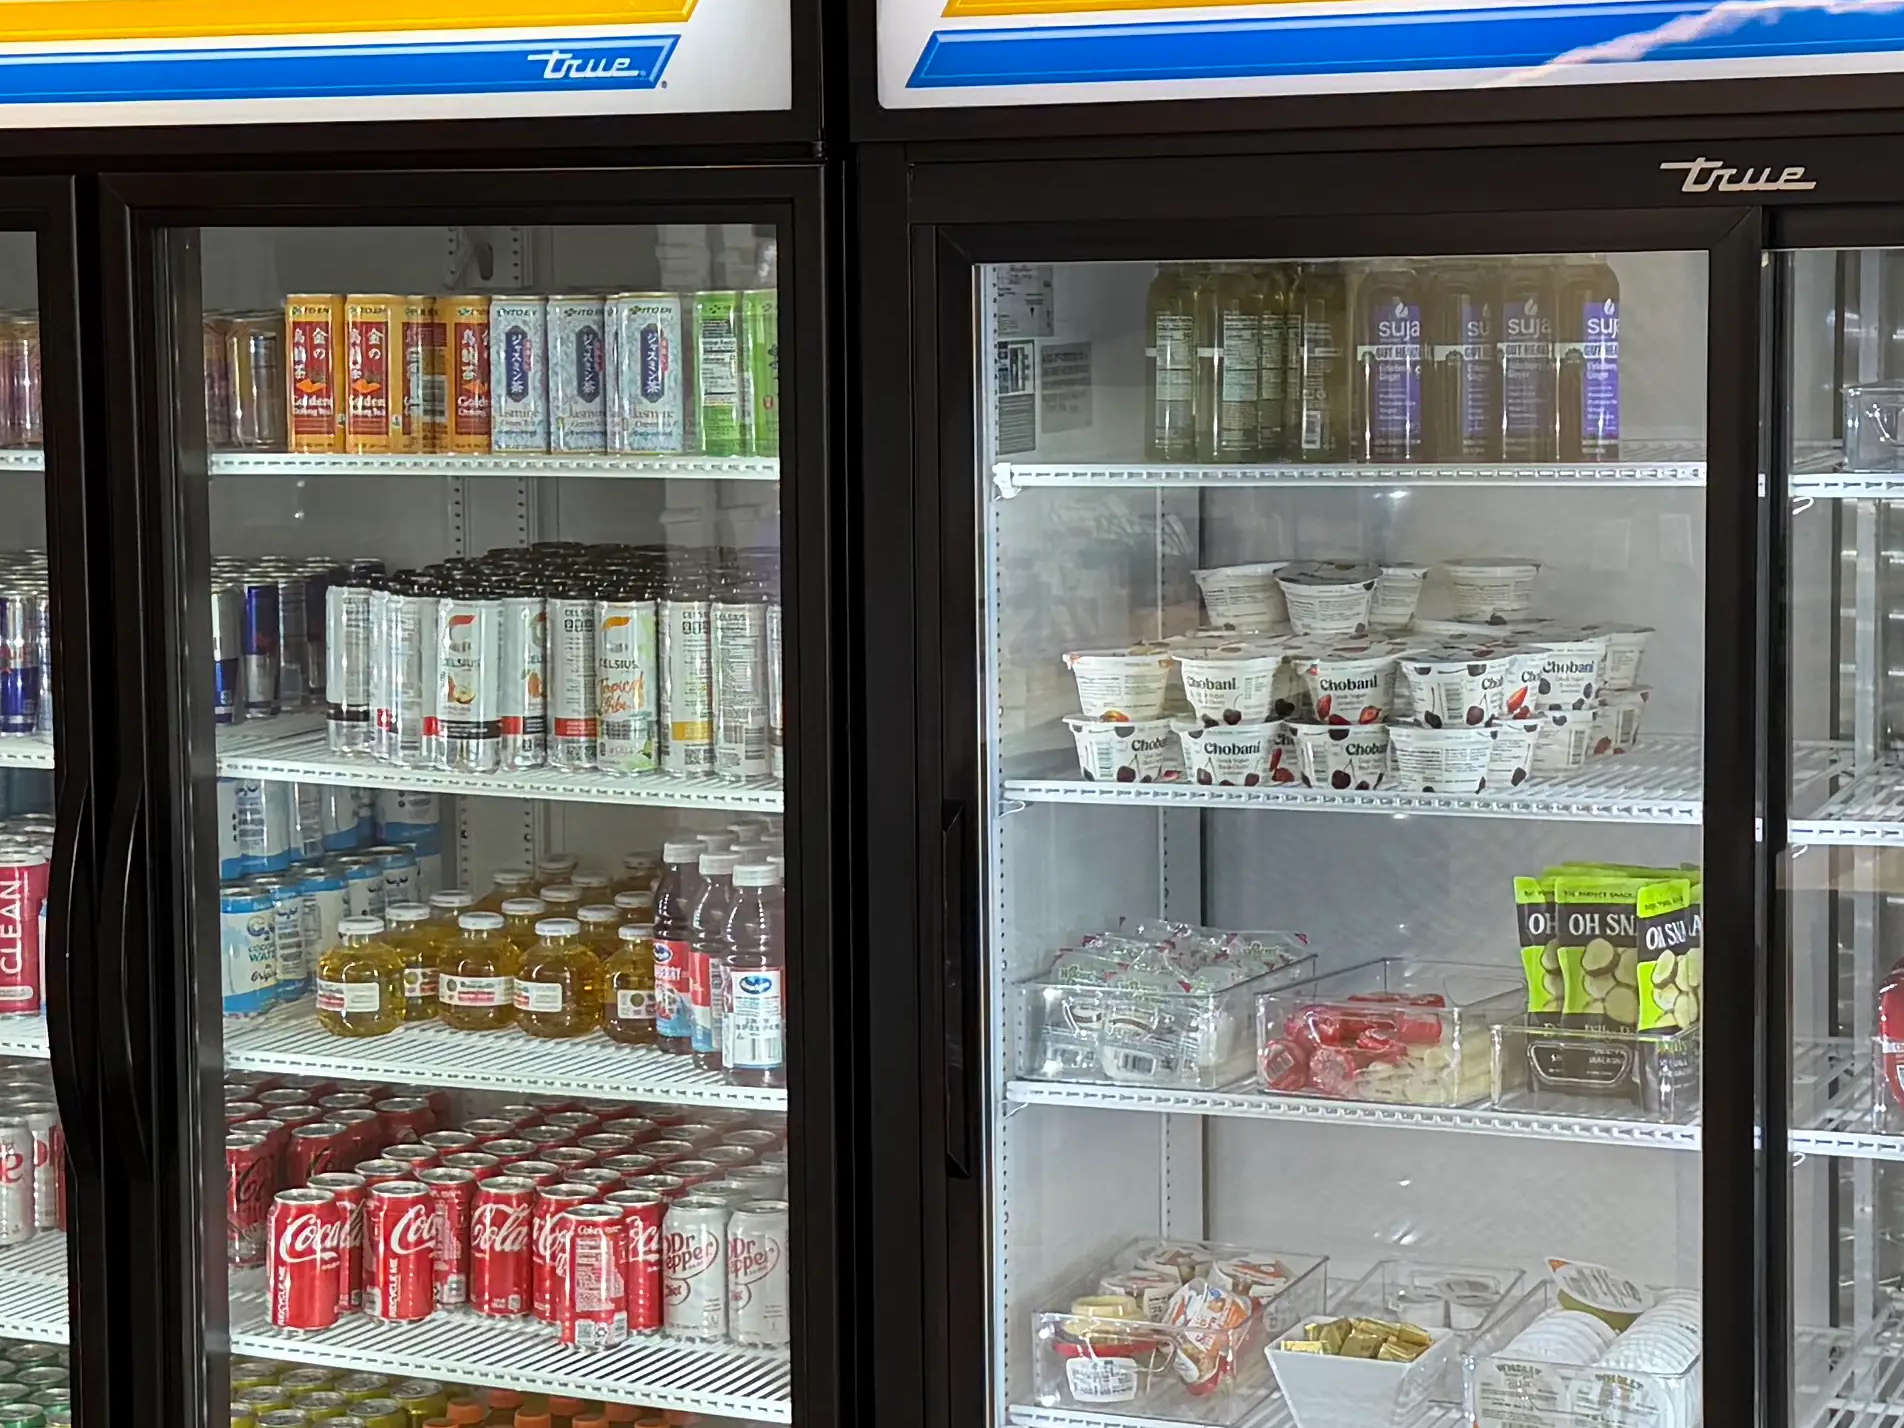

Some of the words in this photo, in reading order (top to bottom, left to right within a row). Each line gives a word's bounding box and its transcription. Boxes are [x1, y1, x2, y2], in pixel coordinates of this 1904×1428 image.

[1379, 320, 1420, 341] suja
[1508, 318, 1552, 338] suja
[510, 333, 523, 393] ジャスミン茶
[582, 333, 595, 394] ジャスミン茶
[647, 332, 661, 394] ジャスミン茶
[1543, 660, 1594, 673] Chobani
[1187, 676, 1237, 691] Chobani
[1320, 674, 1378, 691] Chobani
[1204, 740, 1261, 756] Chobani
[0, 880, 23, 975] CLEAN
[1569, 913, 1600, 936] OH
[1606, 914, 1636, 937] SN
[279, 1213, 339, 1263] Coca
[471, 1203, 530, 1252] Cola
[671, 1232, 695, 1254] Dr
[733, 1237, 756, 1257] Dr
